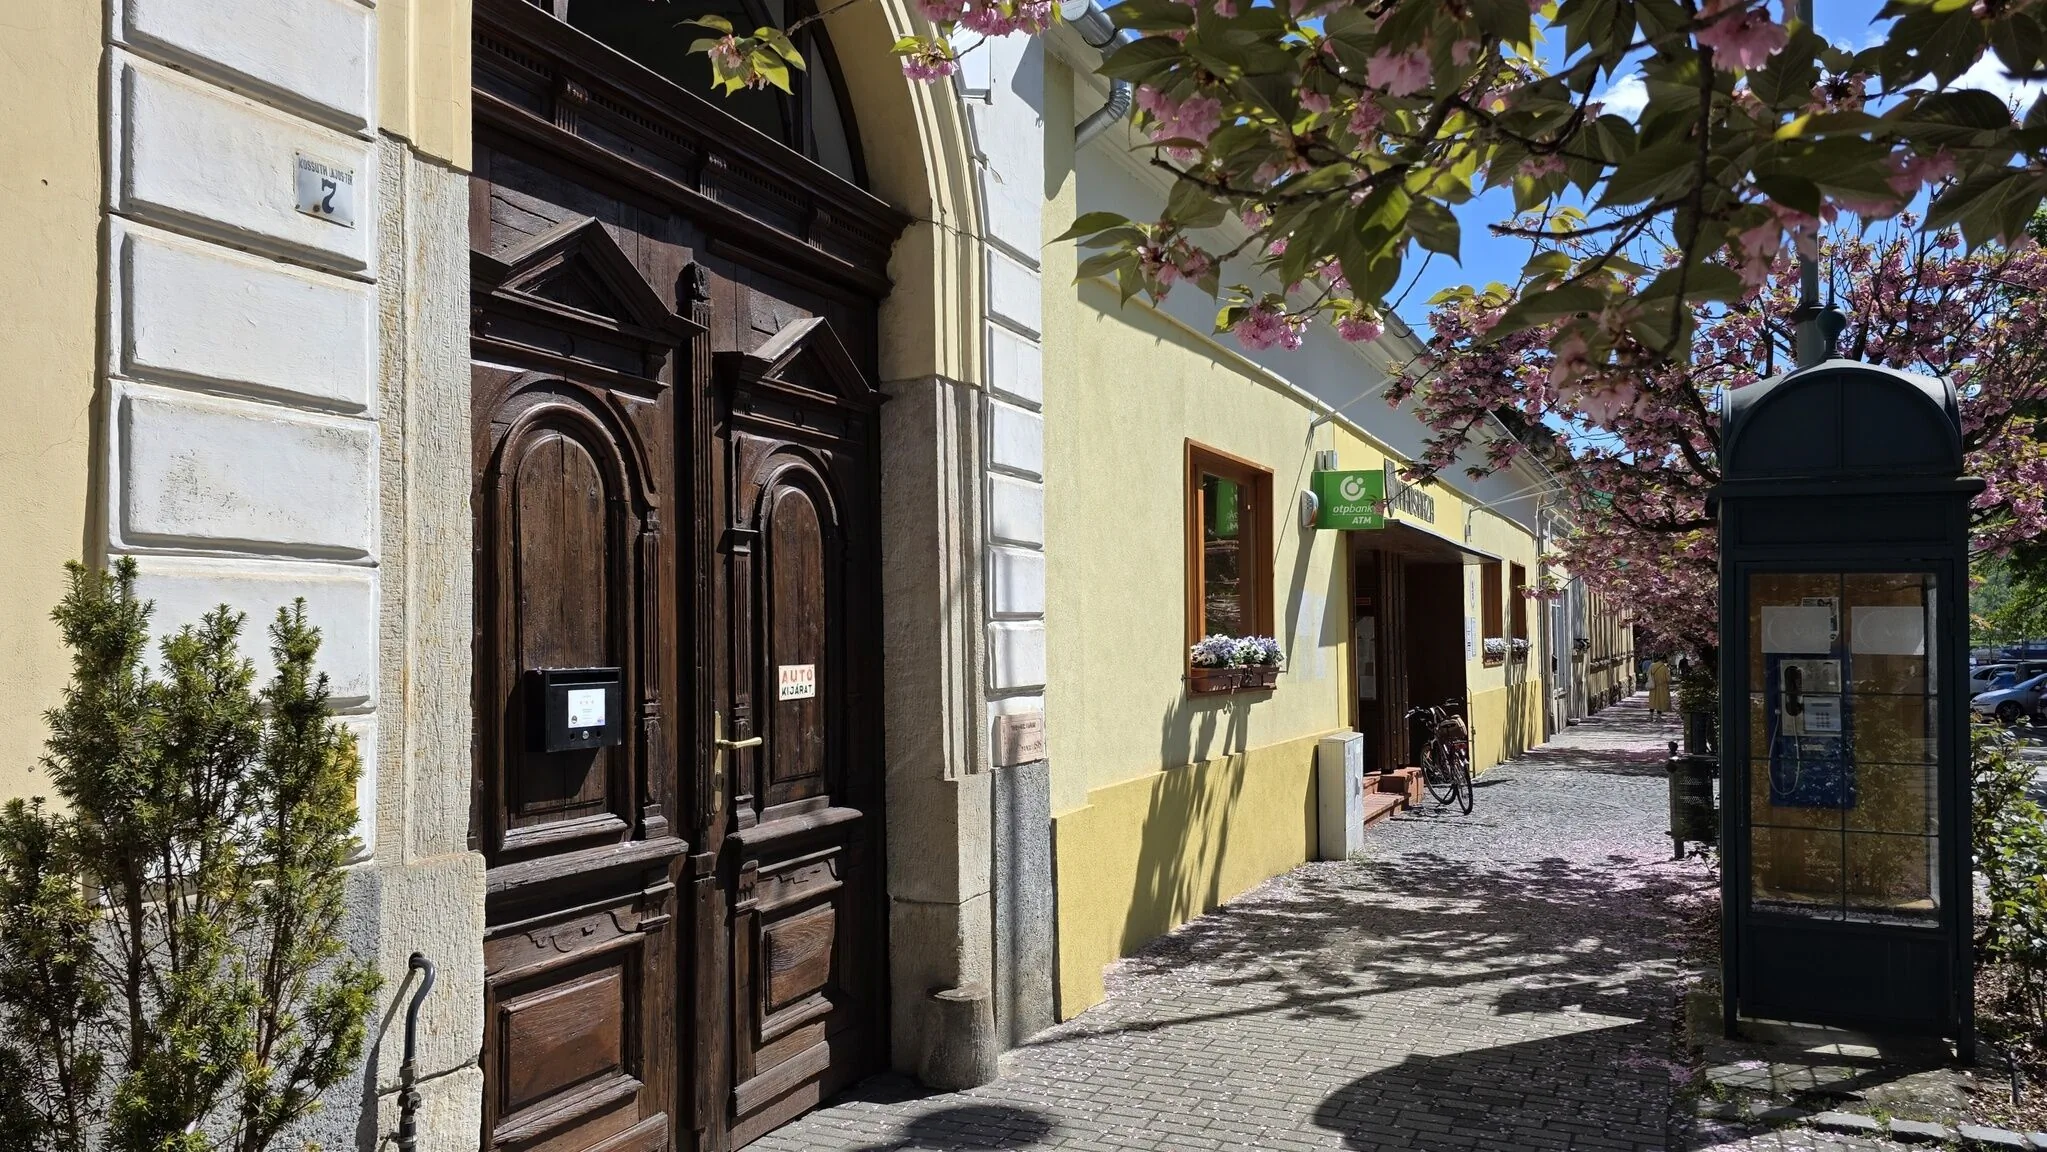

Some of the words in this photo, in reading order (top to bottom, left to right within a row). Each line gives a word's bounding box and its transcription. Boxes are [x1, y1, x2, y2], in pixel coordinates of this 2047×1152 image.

[298, 157, 328, 177] KOSSUTH
[321, 177, 337, 214] 7
[1332, 503, 1373, 516] otpbank
[1351, 516, 1372, 525] ATM
[781, 683, 813, 696] KIJÁRAT
